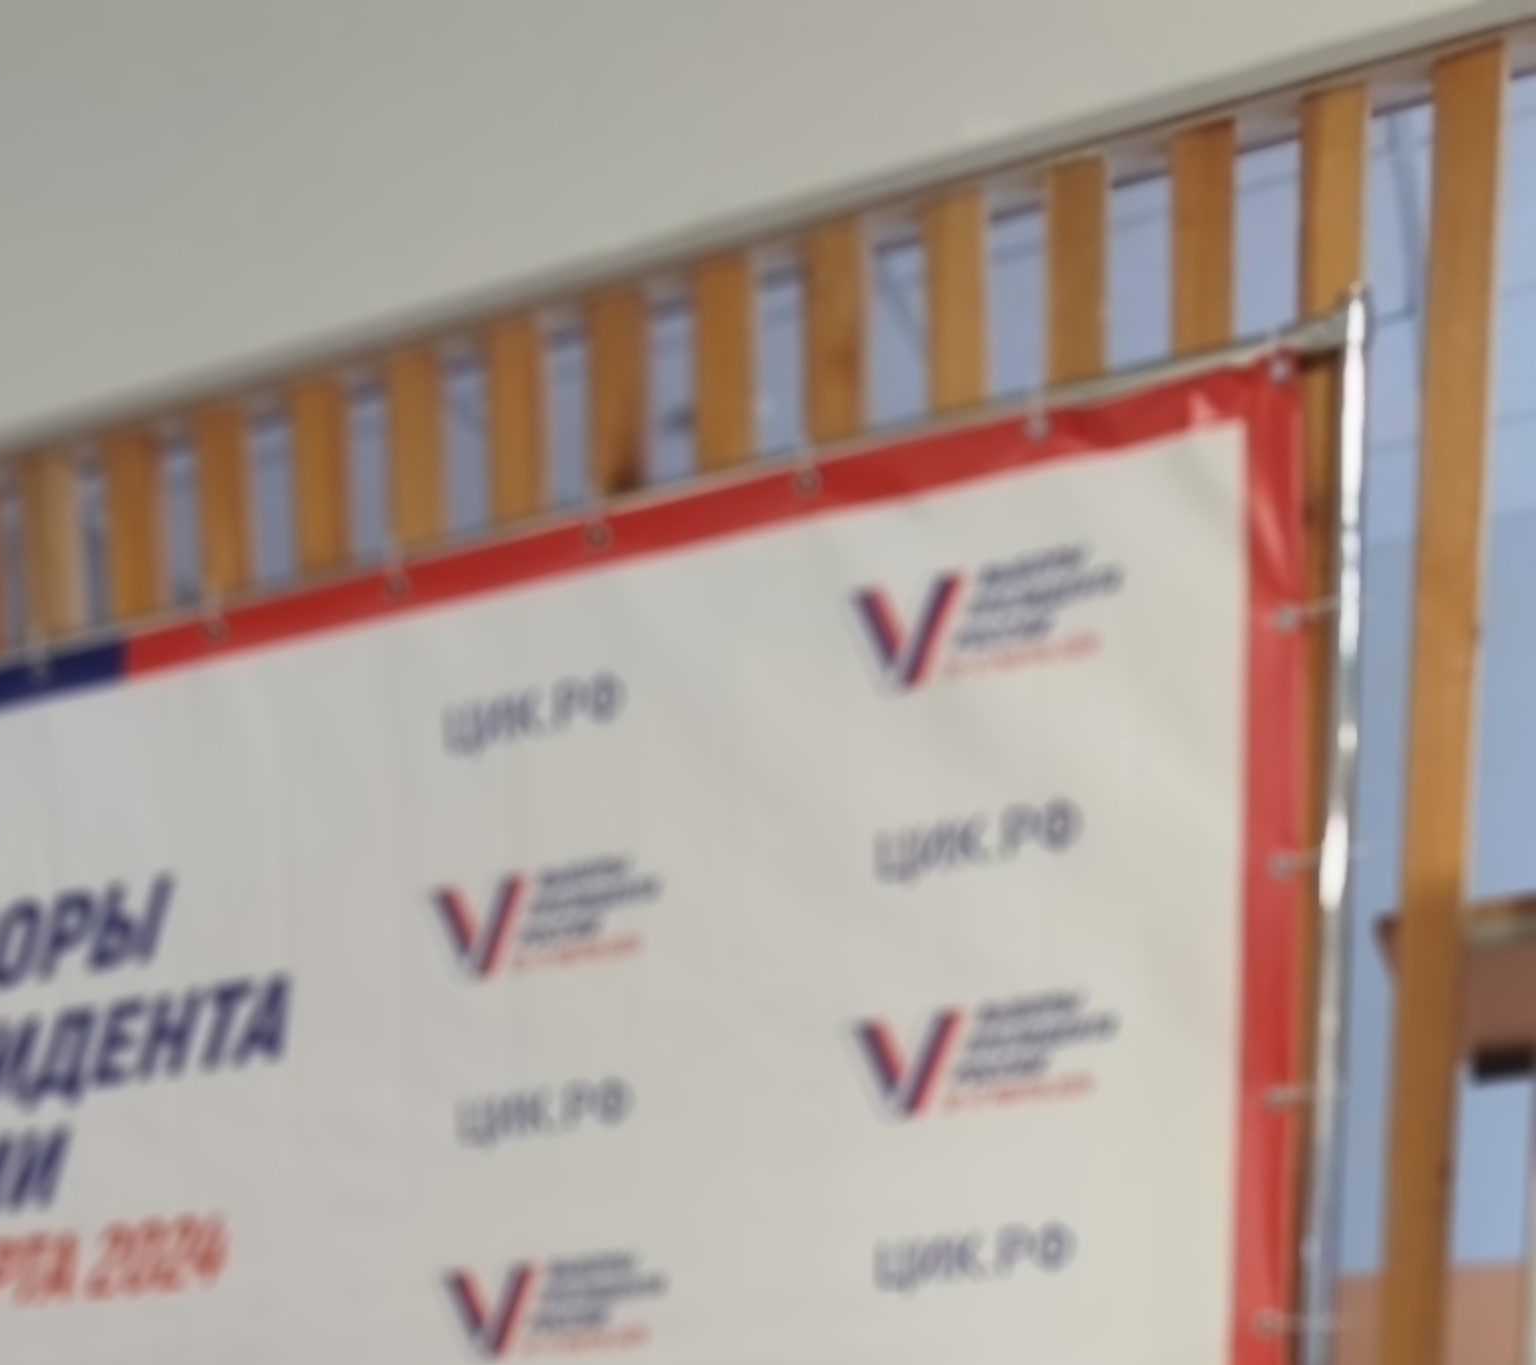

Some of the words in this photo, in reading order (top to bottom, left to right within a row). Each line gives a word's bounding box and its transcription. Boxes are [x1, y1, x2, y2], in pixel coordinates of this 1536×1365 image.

[442, 671, 627, 758] ЦИК.РФ
[873, 798, 1083, 888] ЦИК.РФ
[454, 1076, 634, 1150] ЦИК.РФ
[86, 1212, 229, 1302] 2024
[873, 1220, 1077, 1296] ЦИК.РФ
